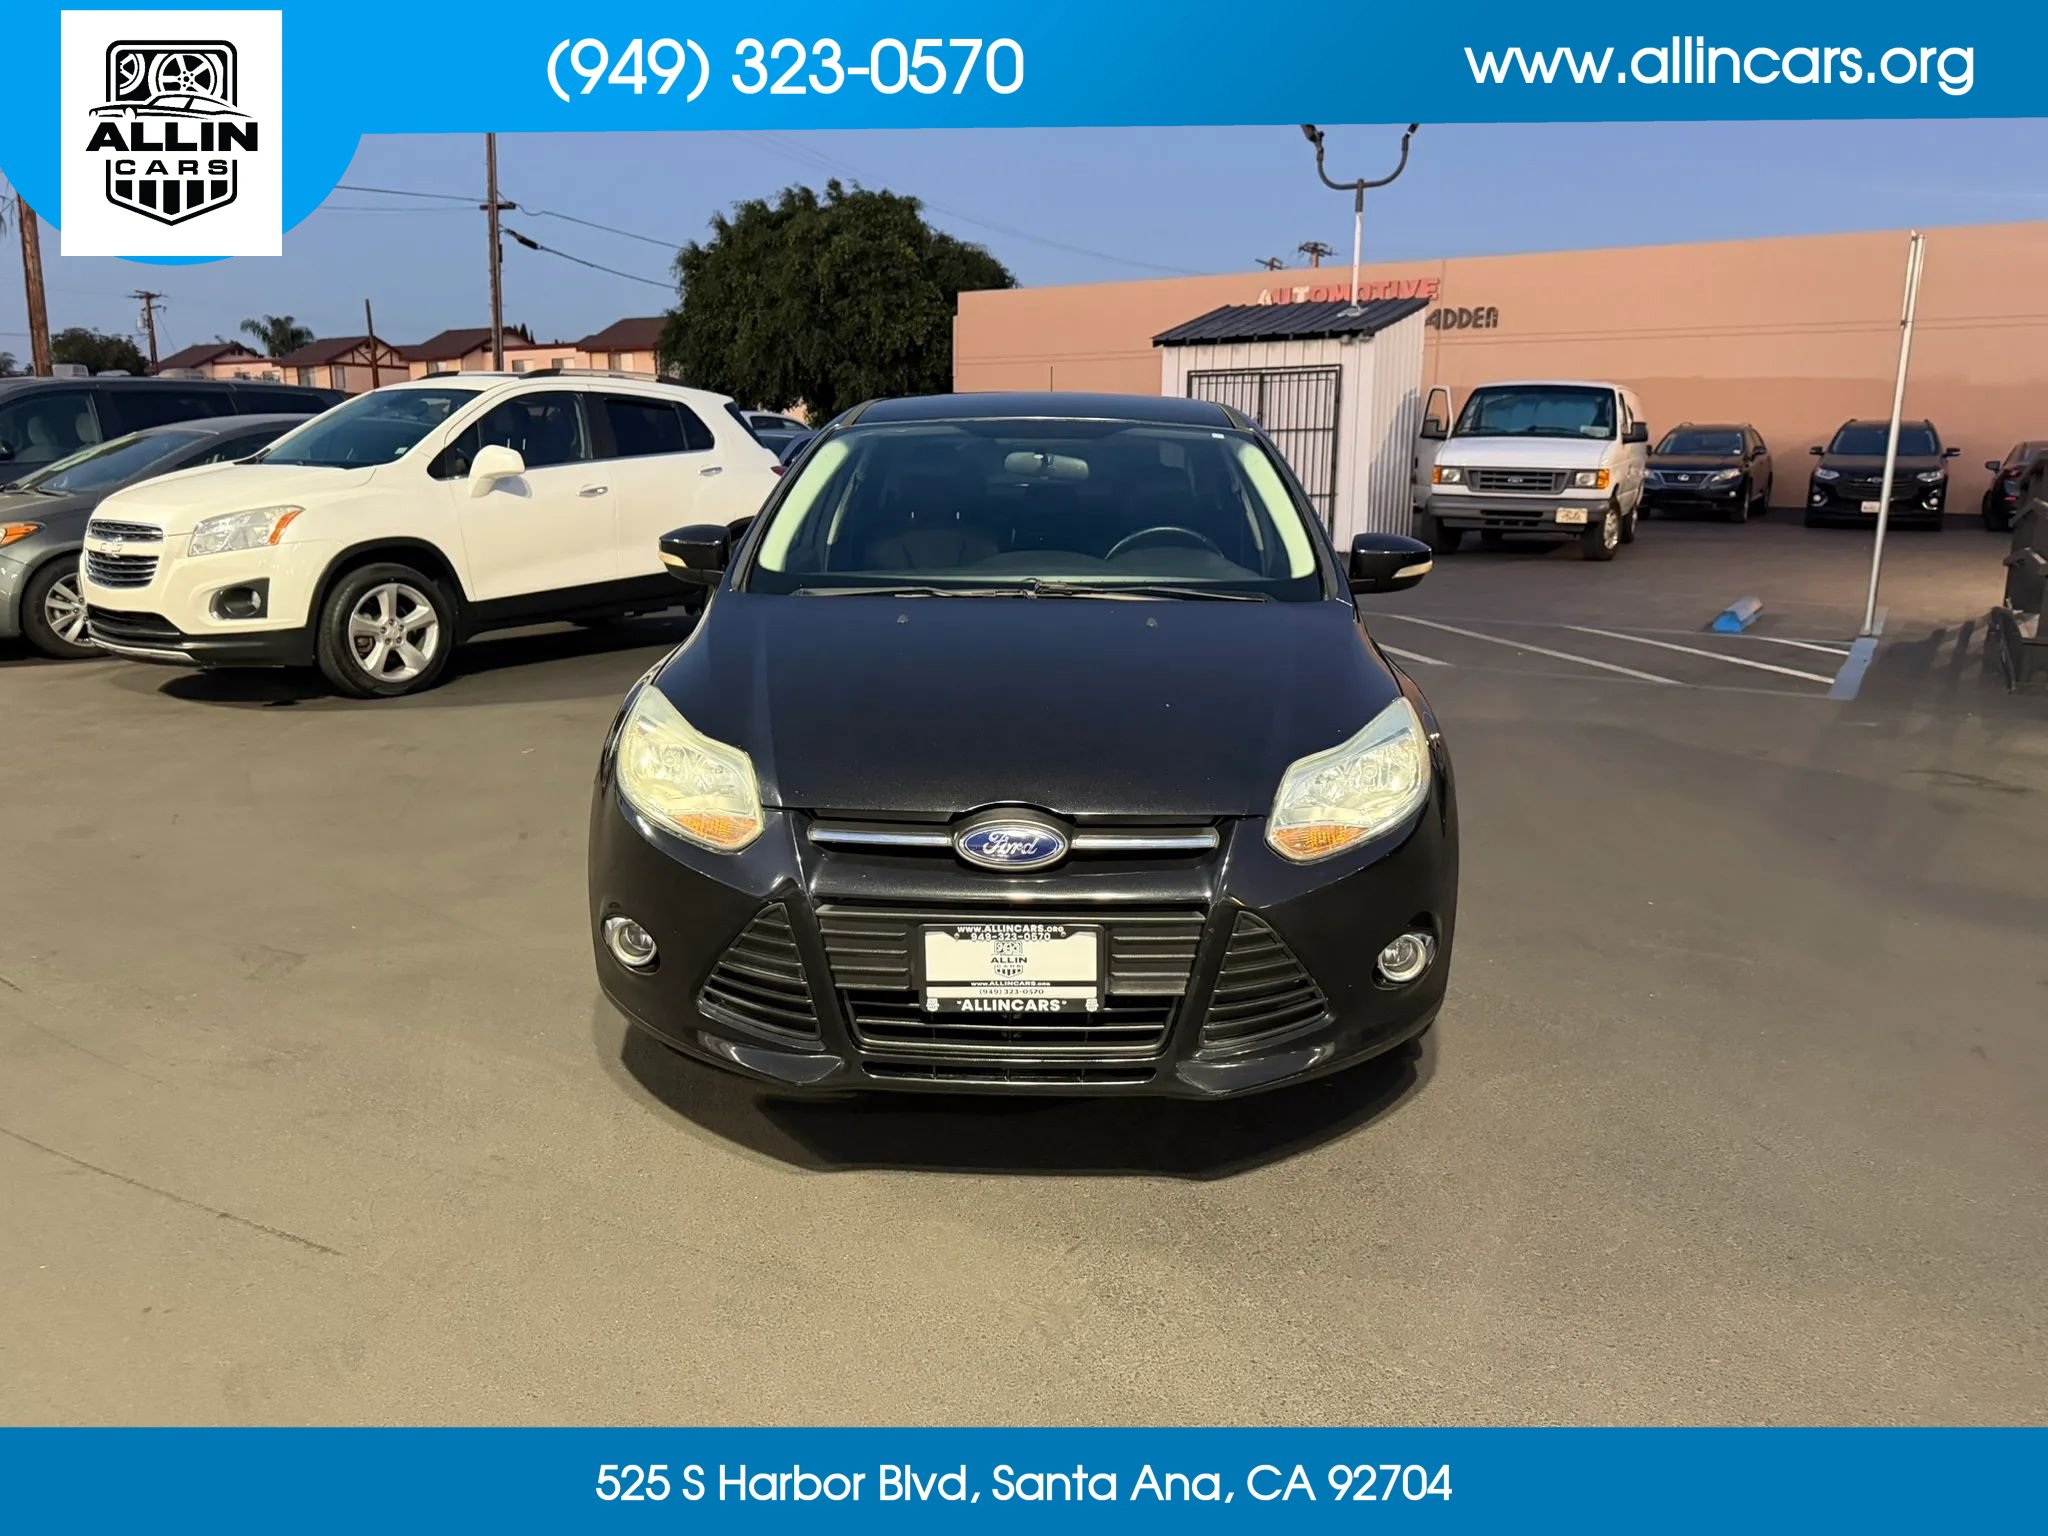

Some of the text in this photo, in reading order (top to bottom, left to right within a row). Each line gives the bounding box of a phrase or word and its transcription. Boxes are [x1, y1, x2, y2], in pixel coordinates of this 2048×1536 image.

[1257, 278, 1440, 306] AUTOMOTIVE
[982, 831, 1040, 855] Ford
[970, 932, 1051, 941] 949-323-0570
[990, 956, 1028, 964] ALLIN
